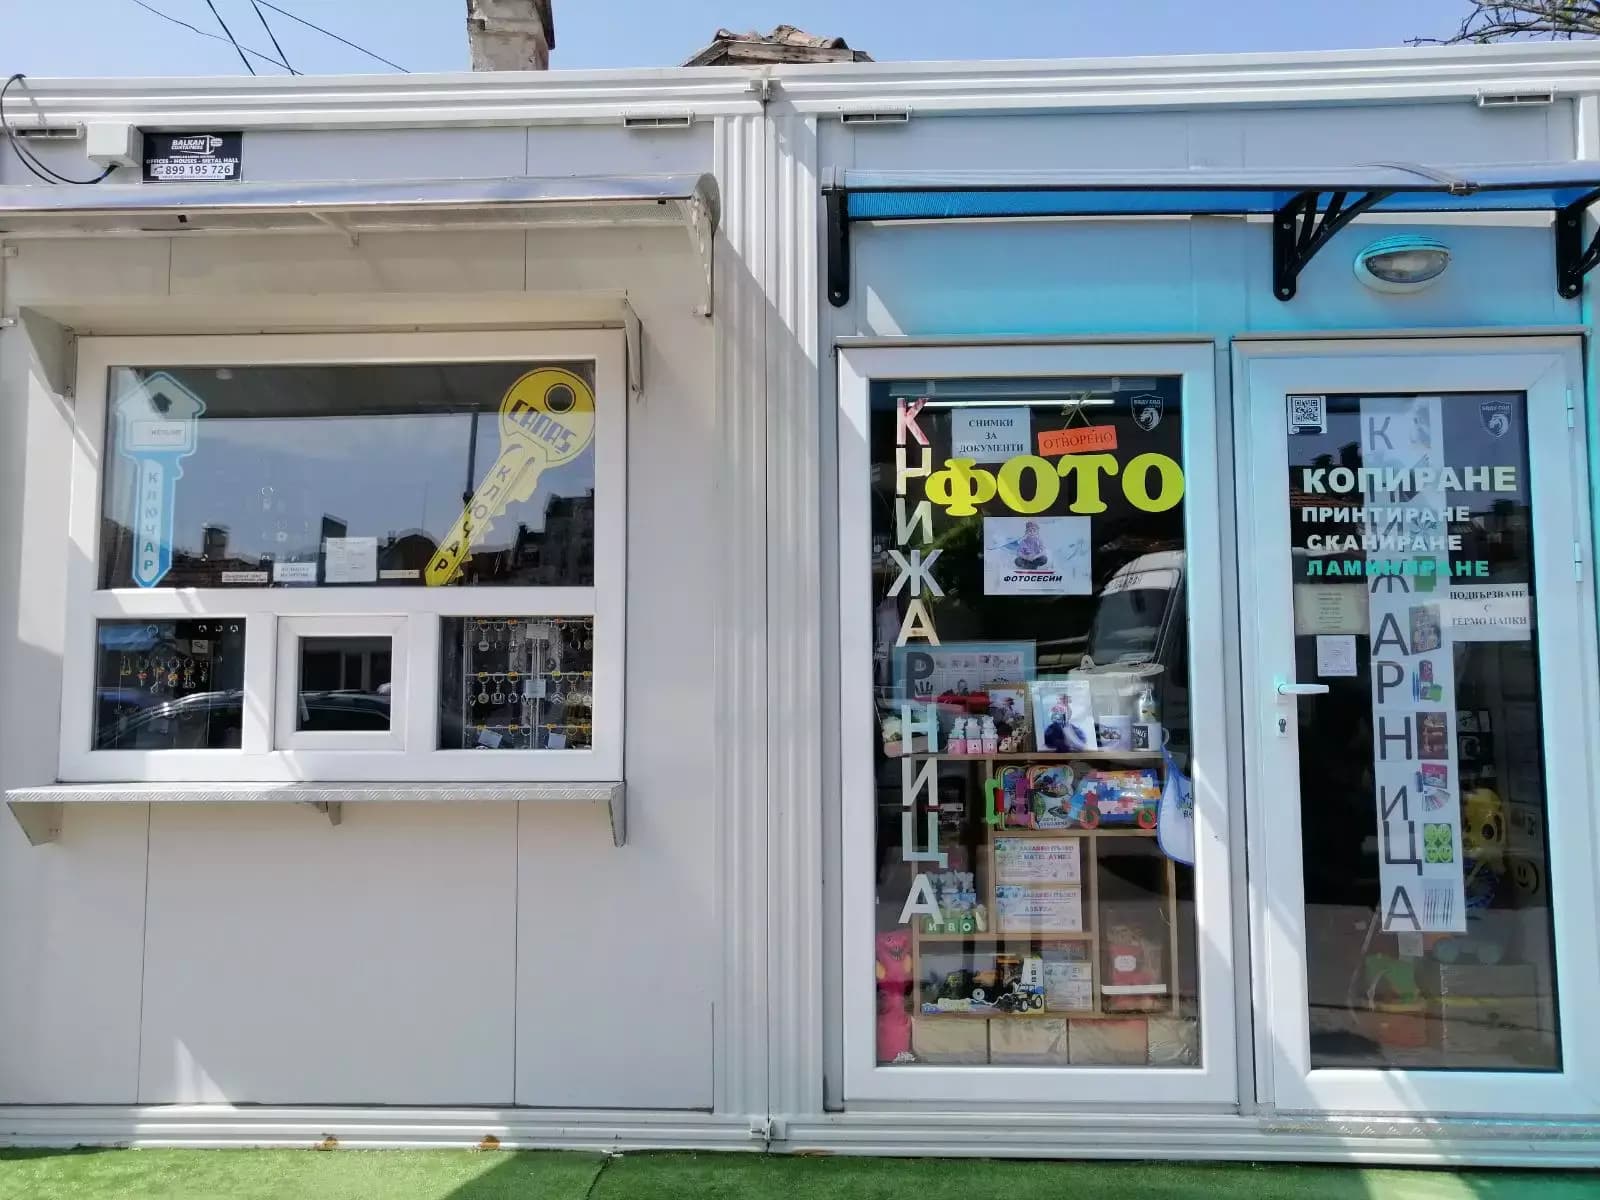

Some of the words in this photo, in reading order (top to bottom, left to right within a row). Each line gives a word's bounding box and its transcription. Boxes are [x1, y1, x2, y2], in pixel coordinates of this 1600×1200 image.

[165, 165, 185, 175] 899
[189, 165, 208, 175] 195
[211, 165, 231, 174] 726
[968, 418, 1014, 428] СНИМКИ
[984, 431, 998, 440] ЗА
[1042, 431, 1114, 450] ОТВОРЕНО
[959, 443, 1024, 454] ДОКУМЕНТИ
[925, 452, 1185, 517] ФОТО
[1302, 465, 1517, 494] КОПИРАНЕ
[143, 471, 159, 571] КЛЮЧАР
[434, 464, 512, 572] КЛЮЧАР
[1301, 505, 1470, 523] ПРИНТИРАНЕ
[1306, 534, 1463, 552] СКАНИРАНЕ
[1306, 559, 1490, 577] ЛАМИНИРАНЕ
[1003, 574, 1063, 583] ФОТОСЕСИИ
[1449, 590, 1526, 600] ПОДВЪРЗВАНЕ
[886, 397, 949, 925] КНИЖАРНИЦА
